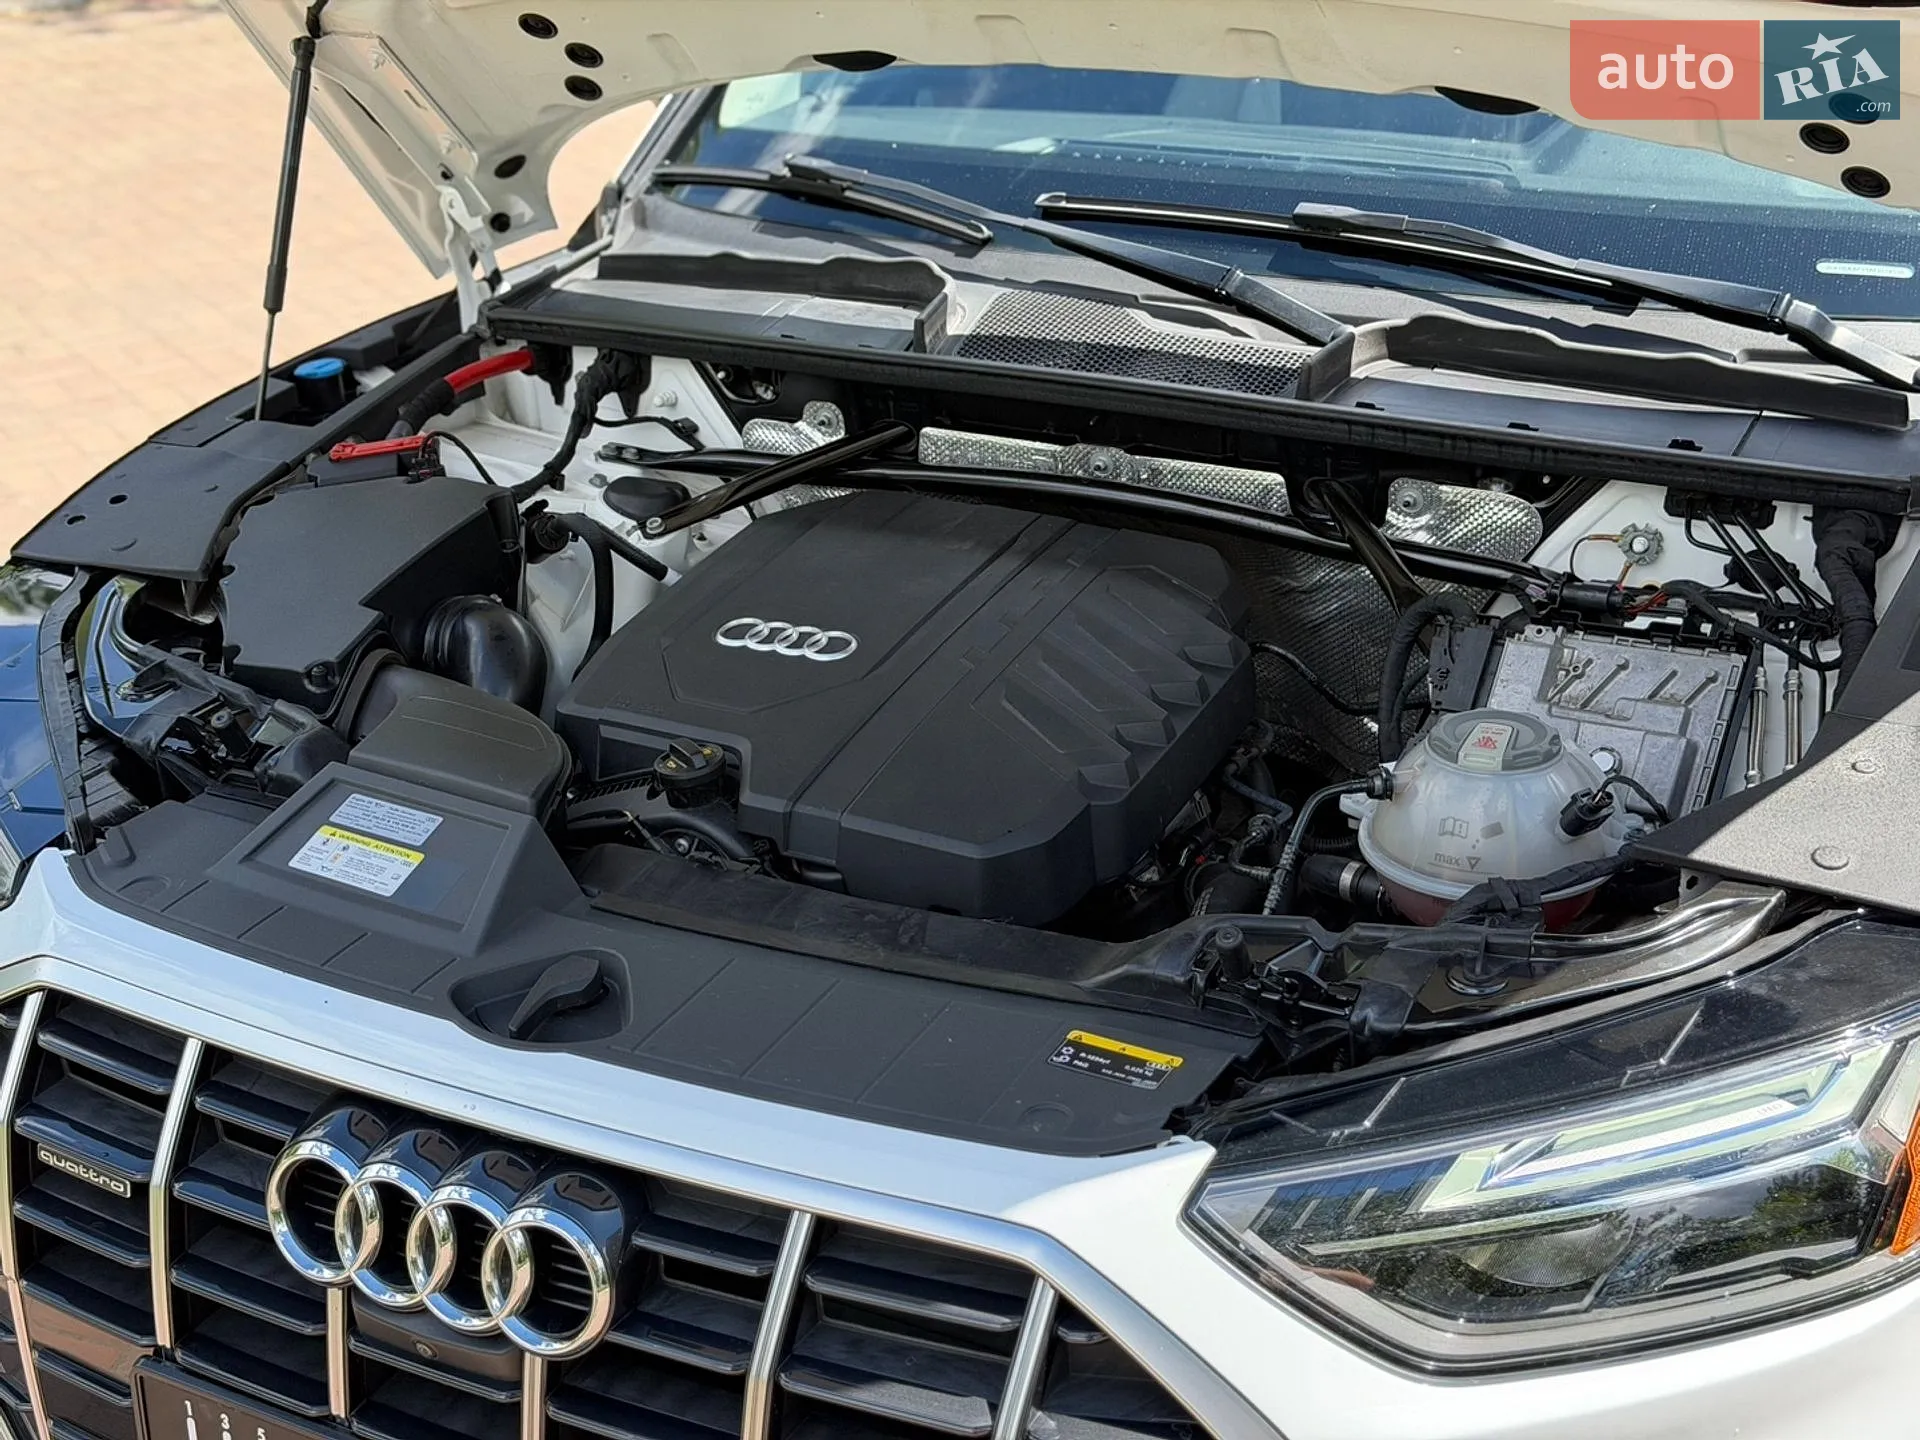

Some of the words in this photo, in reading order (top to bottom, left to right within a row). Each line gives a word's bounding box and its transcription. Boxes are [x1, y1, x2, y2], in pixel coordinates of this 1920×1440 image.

[1434, 852, 1460, 866] max
[40, 1150, 124, 1192] quattro
[220, 1413, 230, 1429] 3
